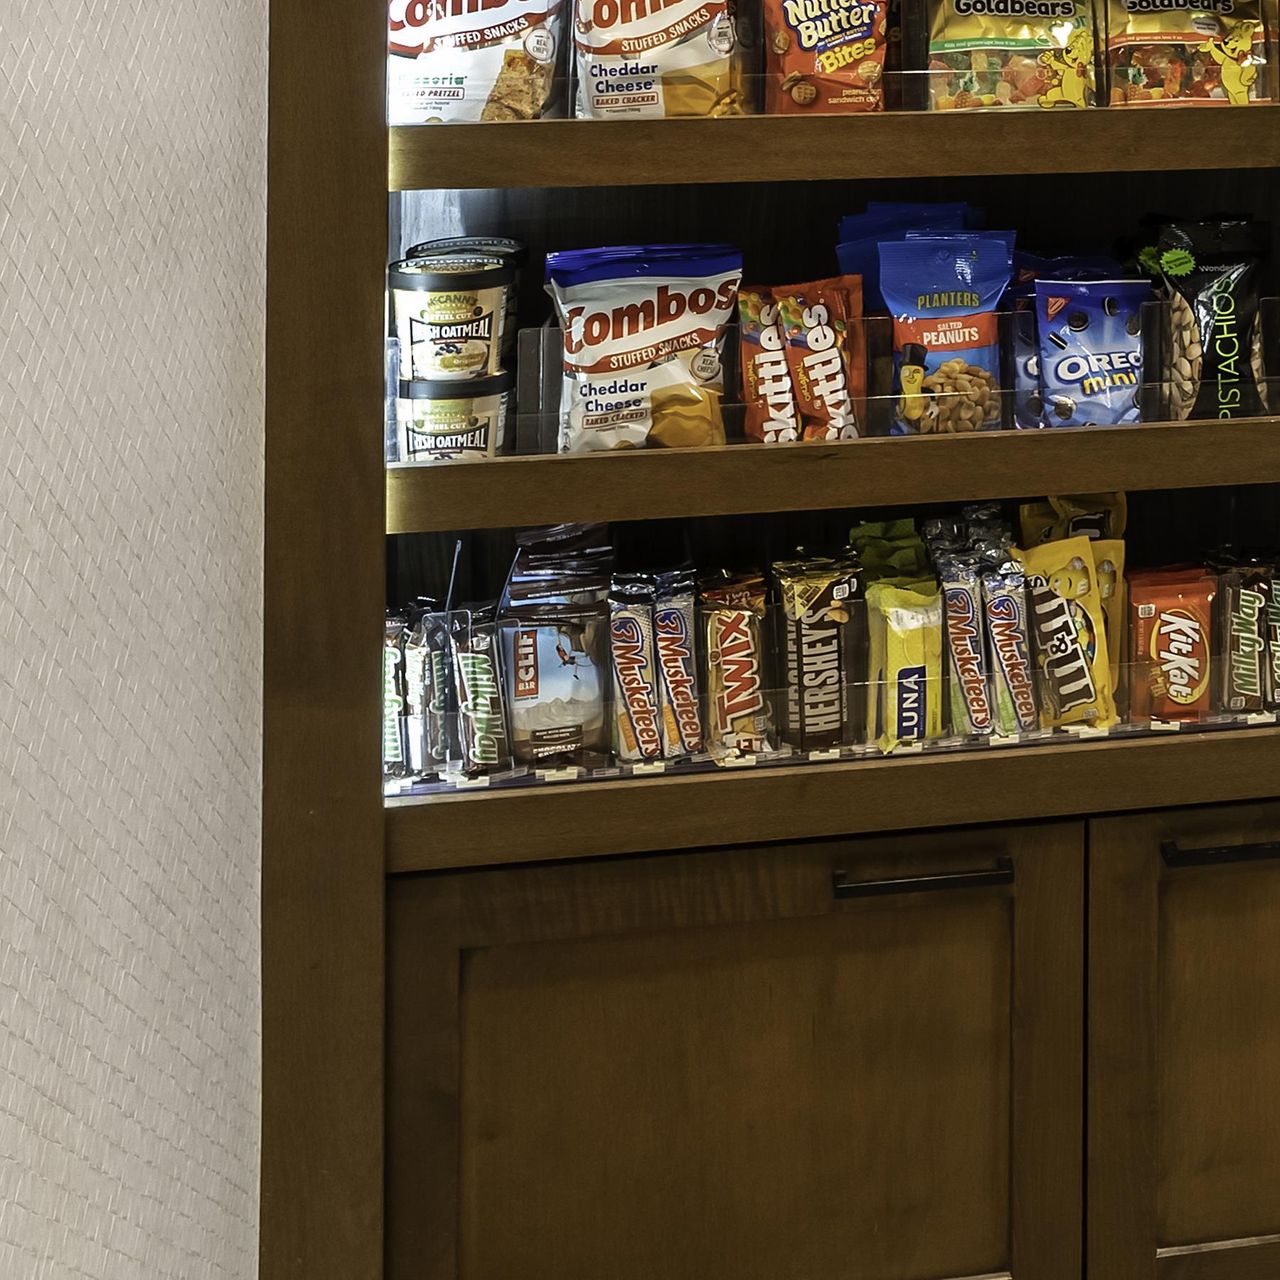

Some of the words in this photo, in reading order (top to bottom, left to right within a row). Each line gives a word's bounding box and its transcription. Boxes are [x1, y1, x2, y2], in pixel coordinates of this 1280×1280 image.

[621, 32, 668, 52] STUFFED
[669, 9, 710, 37] SNACKS
[797, 3, 875, 48] Butter
[820, 37, 876, 75] Bites
[589, 63, 658, 78] Cheddar
[427, 89, 462, 98] PRETZEL
[595, 78, 655, 93] Cheese
[594, 97, 619, 106] BAKED
[622, 94, 656, 106] CRACKER
[828, 95, 868, 104] sandwich
[917, 292, 980, 310] PLANTERS
[923, 328, 979, 346] PEANUTS
[937, 322, 963, 331] SALTED
[610, 346, 656, 369] STUFFED
[658, 332, 701, 356] SNACKS
[579, 380, 647, 397] Cheddar
[1082, 368, 1137, 396] mini
[585, 396, 643, 412] Cheese
[611, 618, 642, 643] 3
[518, 632, 536, 681] CLIF
[715, 611, 763, 731] TWIX
[801, 609, 841, 734] HERSHEY'S
[518, 681, 536, 691] BAR
[613, 641, 661, 759] Musketeers
[901, 673, 919, 740] LUNA
